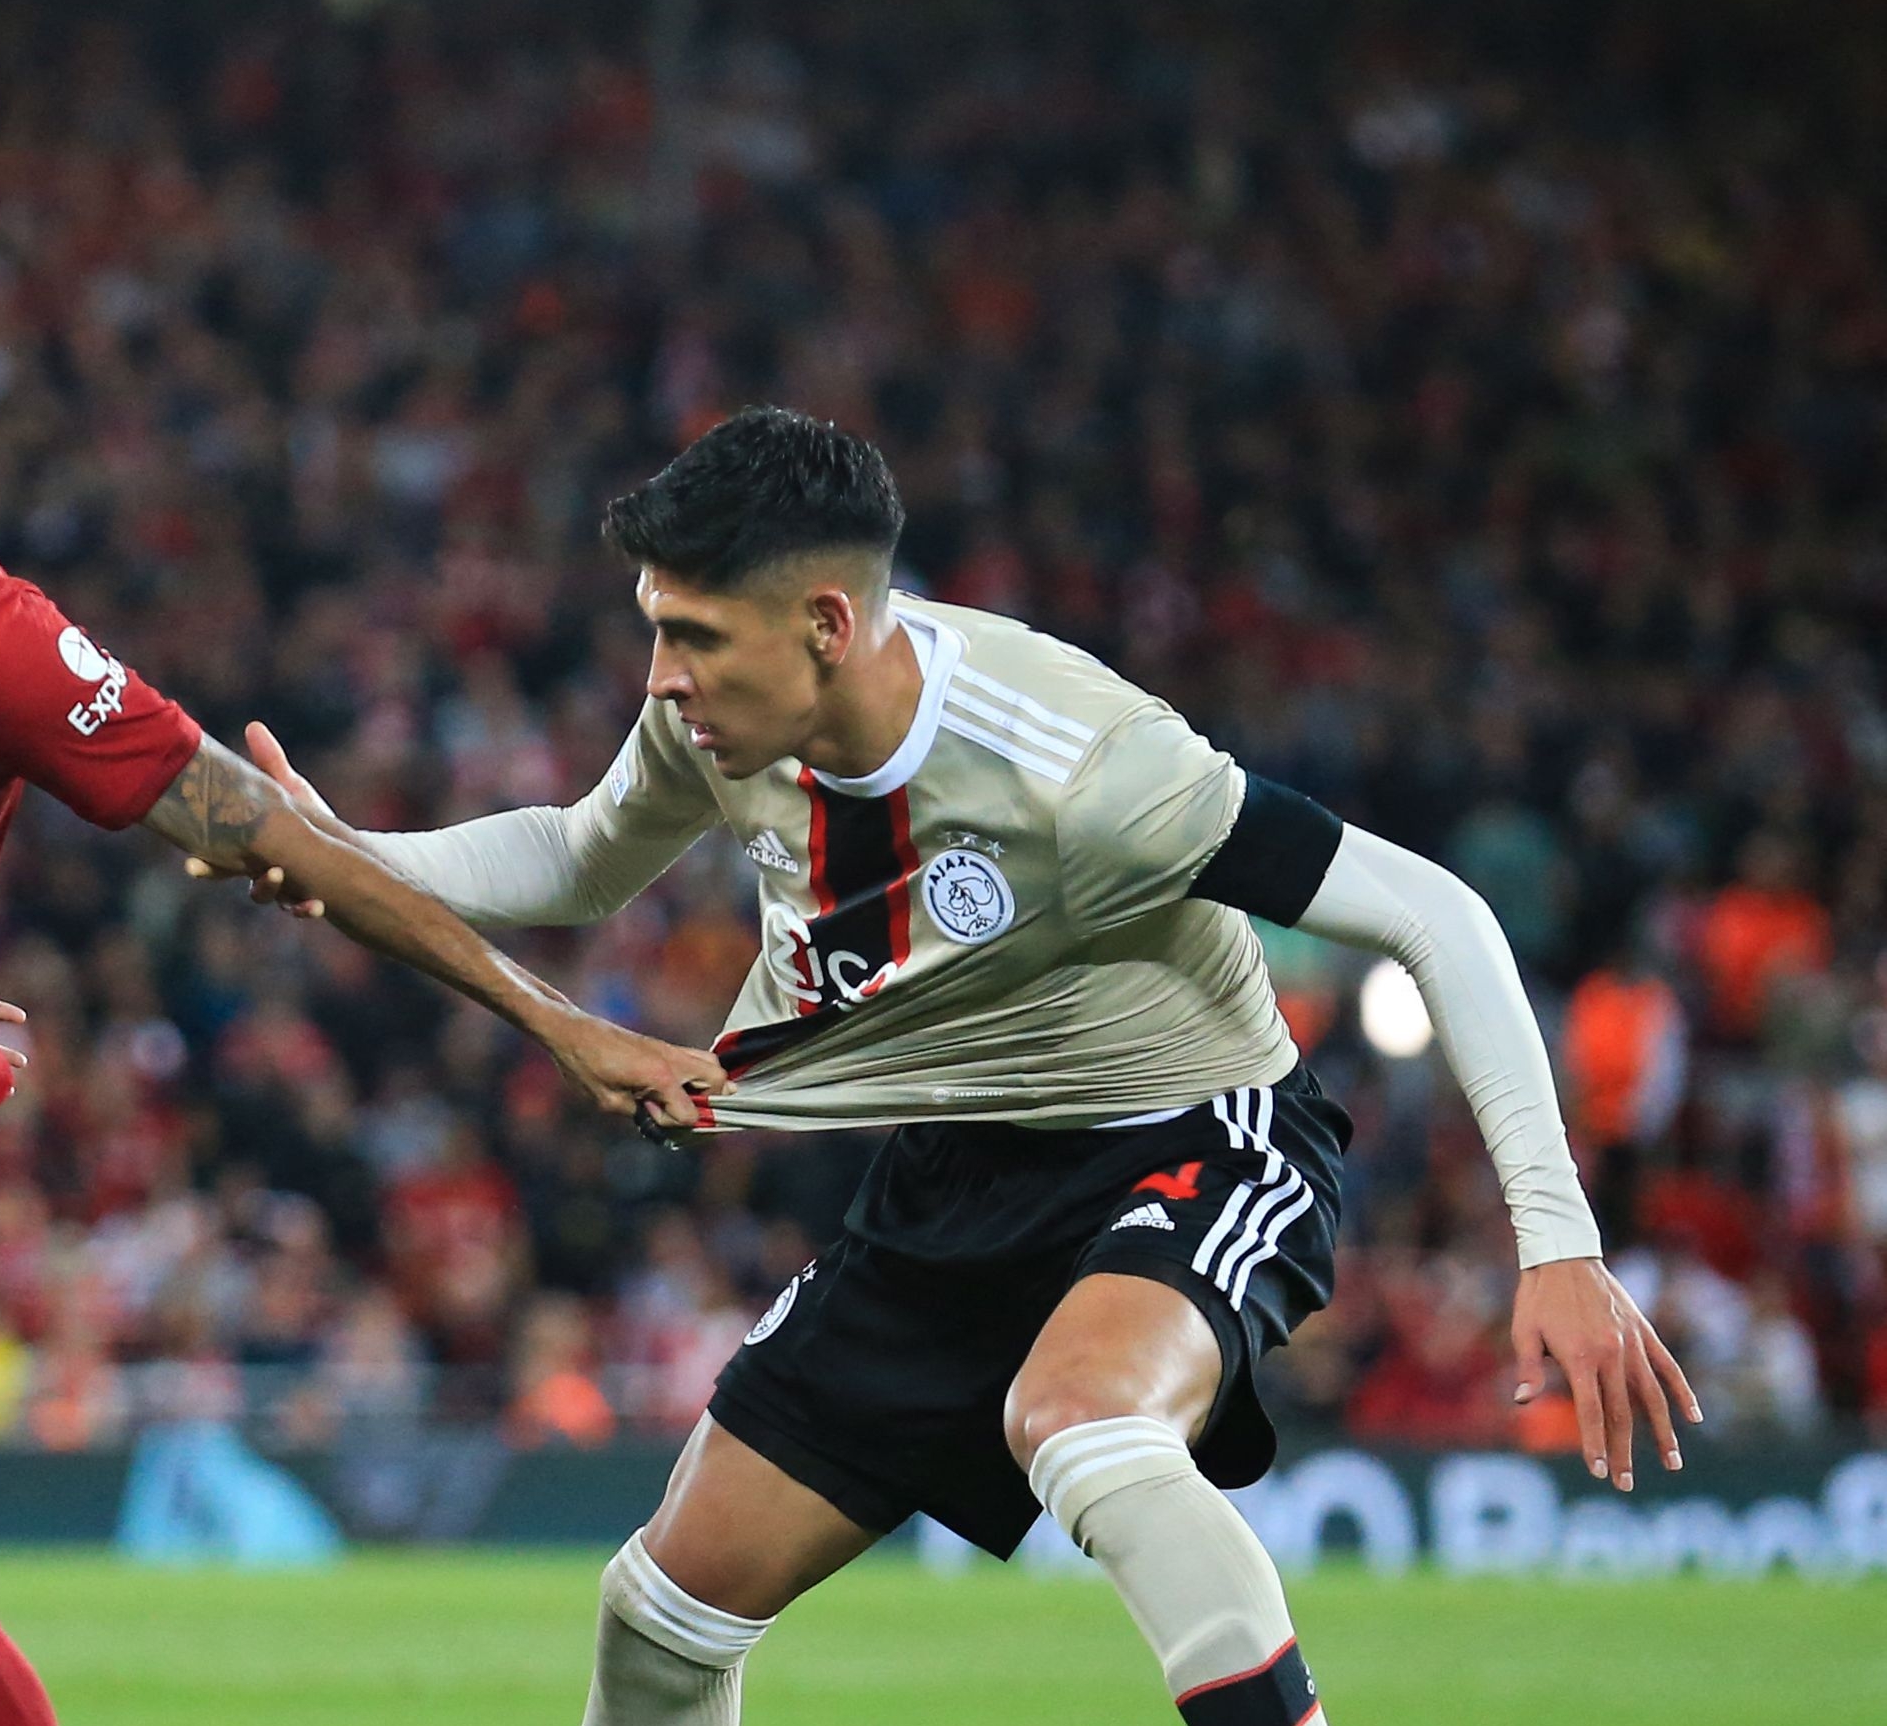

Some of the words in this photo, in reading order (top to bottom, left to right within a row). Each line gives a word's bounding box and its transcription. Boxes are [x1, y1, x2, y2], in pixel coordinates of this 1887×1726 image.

[746, 847, 799, 873] adidas
[929, 855, 967, 886] AJAX
[1111, 1219, 1175, 1232] adidas
